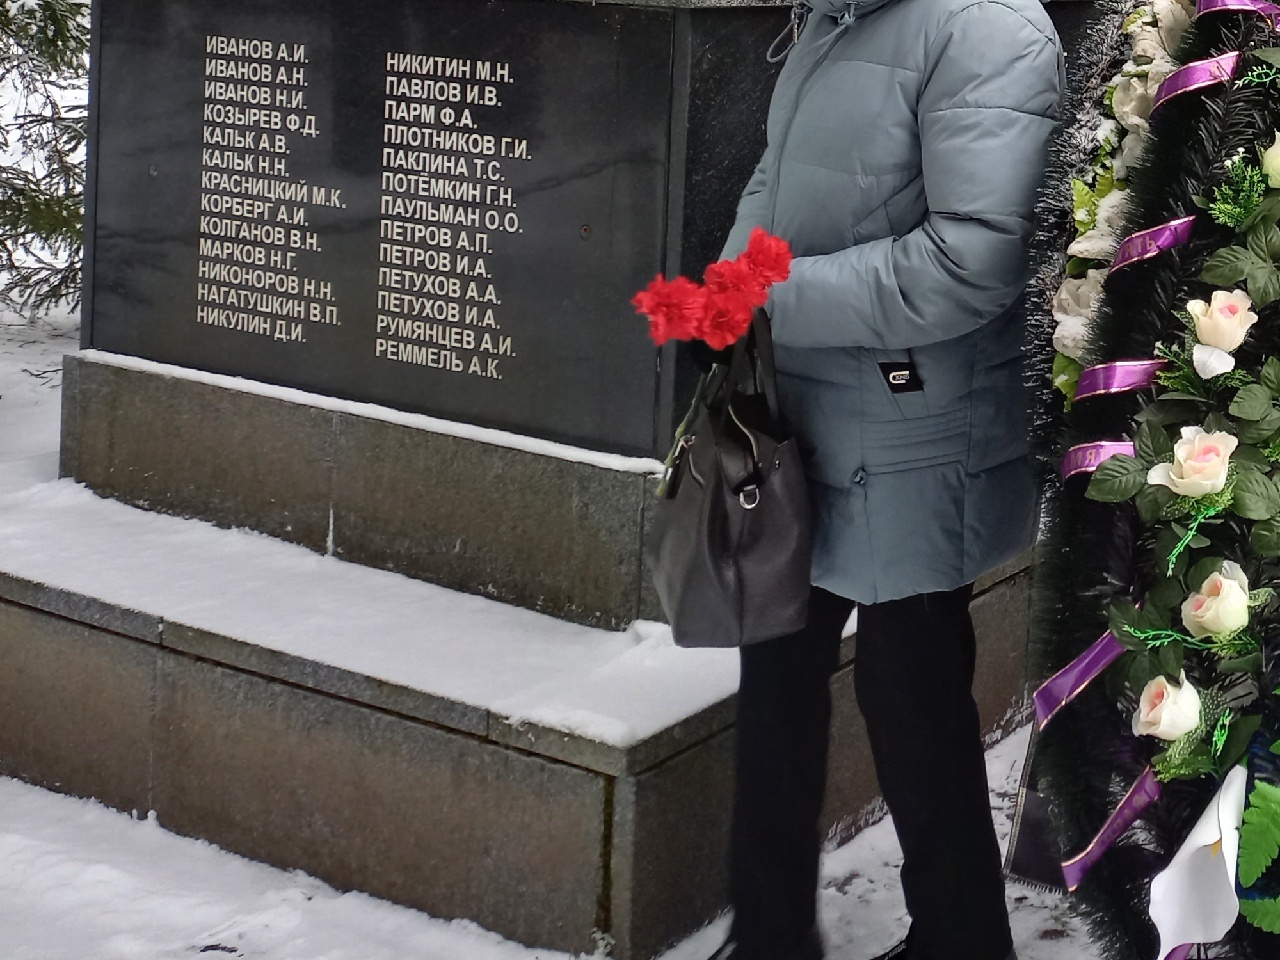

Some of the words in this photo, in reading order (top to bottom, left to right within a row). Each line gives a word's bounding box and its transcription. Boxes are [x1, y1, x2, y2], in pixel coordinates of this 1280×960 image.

[206, 36, 272, 58] ИВАНОВ
[276, 44, 308, 63] А.И.
[205, 58, 272, 81] ИВАНОВ
[276, 66, 308, 86] А.Н.
[386, 52, 470, 79] НИКИТИН
[476, 62, 514, 83] М.Н.
[204, 81, 271, 105] ИВАНОВ
[275, 90, 307, 109] Н.И.
[385, 76, 460, 102] ПАВЛОВ
[466, 86, 502, 106] И.В.
[204, 104, 281, 130] КОЗЫРЕВ
[286, 112, 320, 137] Ф.Д.
[385, 101, 435, 123] ПАРМ
[440, 107, 477, 128] Ф.А.
[203, 126, 255, 149] КАЛЬК
[258, 134, 290, 154] А.В.
[384, 124, 495, 155] ПЛОТНИКОВ
[500, 138, 532, 159] Г.И.
[202, 148, 254, 170] КАЛЬК
[258, 157, 289, 176] Н.Н.
[383, 148, 468, 176] ПАКЛИНА
[472, 159, 505, 181] Т.С.
[201, 172, 307, 202] КРАСНИЦКИЙ
[312, 186, 346, 208] М.К.
[382, 172, 481, 202] ПОТЁМКИН
[486, 185, 516, 207] Г.Н.
[201, 193, 272, 219] КОРБЕРГ
[276, 206, 308, 226] А.И.
[381, 196, 479, 227] ПАУЛЬМАН
[485, 210, 522, 233] О.О.
[200, 216, 285, 244] КОЛГАНОВ
[289, 230, 321, 252] В.Н.
[380, 219, 451, 246] ПЕТРОВ
[456, 231, 492, 253] А.П.
[199, 238, 265, 265] МАРКОВ
[270, 250, 297, 271] Н.Г.
[379, 243, 451, 271] ПЕТРОВ
[456, 255, 491, 278] И.А.
[198, 261, 298, 294] НИКОНОРОВ
[303, 279, 335, 301] Н.Н.
[378, 267, 460, 297] ПЕТУХОВ
[465, 280, 501, 304] А.А.
[198, 283, 305, 319] НАГАТУШКИН
[309, 304, 341, 325] В.П.
[378, 290, 459, 322] ПЕТУХОВ
[465, 305, 500, 329] И.А.
[197, 305, 271, 335] НИКУЛИН
[274, 321, 306, 342] Д.И.
[377, 314, 474, 349] РУМЯНЦЕВ
[479, 332, 516, 356] А.И.
[376, 338, 463, 371] РЕММЕЛЬ
[468, 355, 502, 379] А.К.
